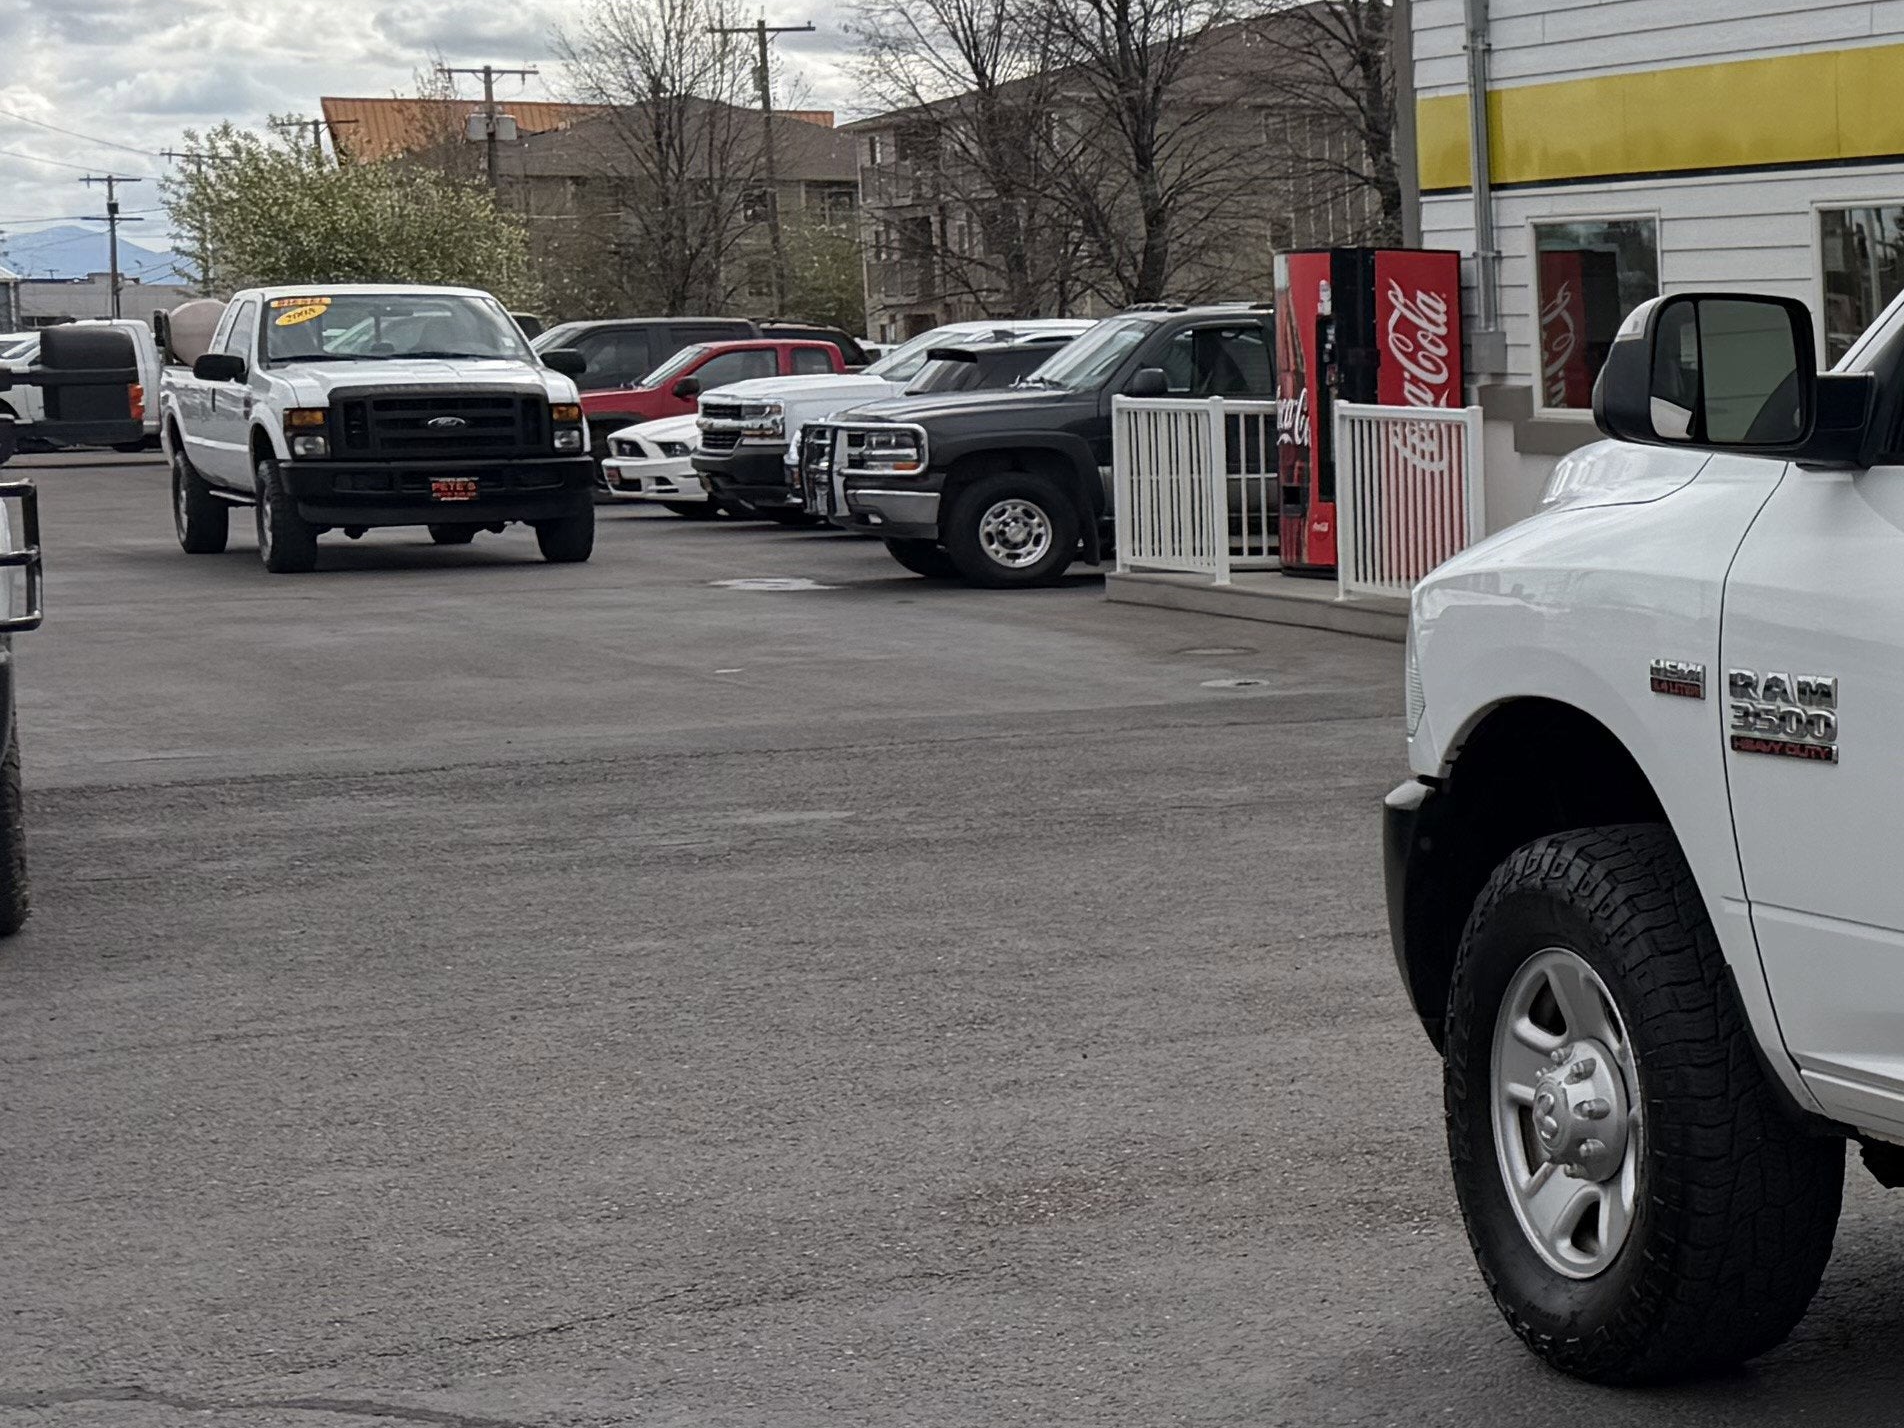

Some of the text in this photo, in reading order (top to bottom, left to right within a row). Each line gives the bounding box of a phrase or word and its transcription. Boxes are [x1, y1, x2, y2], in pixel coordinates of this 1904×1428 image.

[1388, 278, 1449, 471] Ca-Cola
[1729, 668, 1838, 709] RAM
[1730, 701, 1838, 742] 3500
[1734, 737, 1830, 760] HEAVY DUTY
